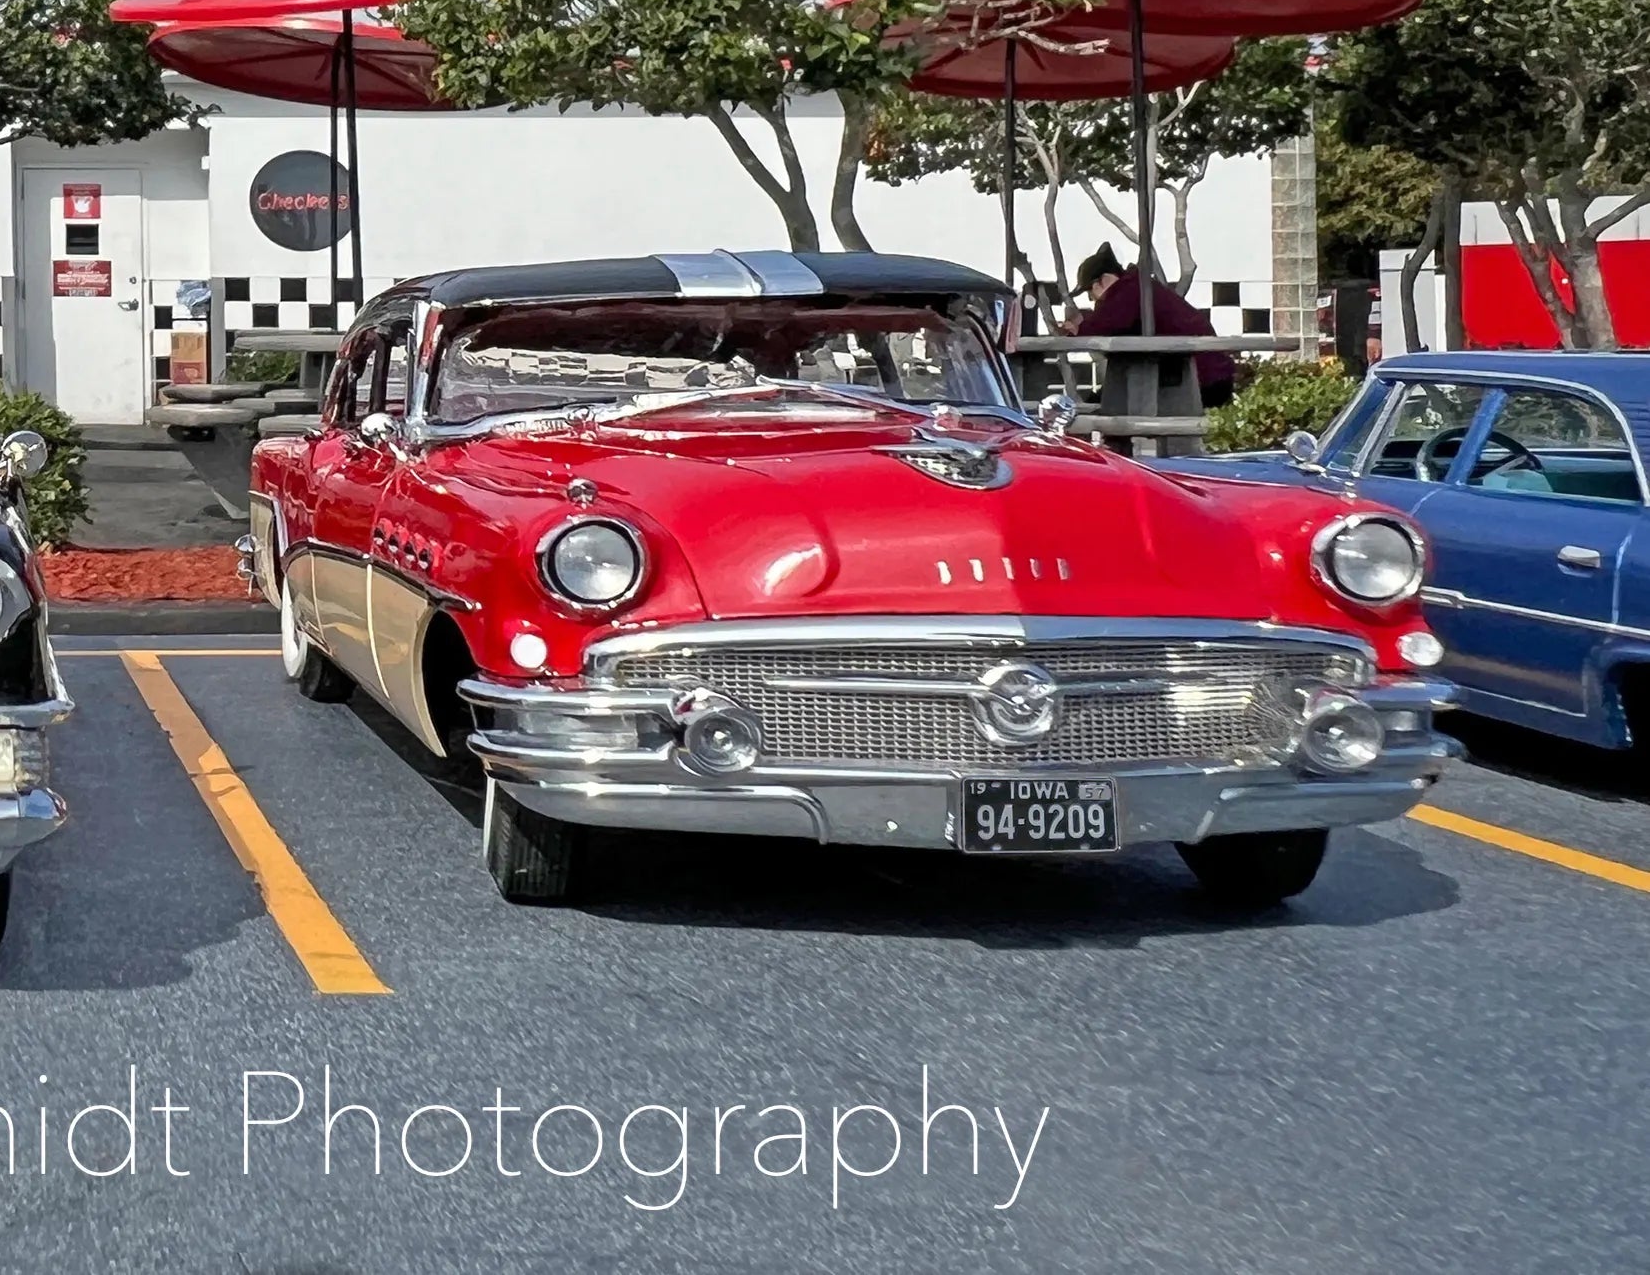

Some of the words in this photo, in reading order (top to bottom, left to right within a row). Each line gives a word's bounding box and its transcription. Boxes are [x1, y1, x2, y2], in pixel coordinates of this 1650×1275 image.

[257, 192, 350, 210] Checkes
[969, 782, 987, 795] 19
[1009, 780, 1070, 800] IOWA
[1084, 787, 1106, 800] 57
[976, 803, 1106, 841] 94-9209
